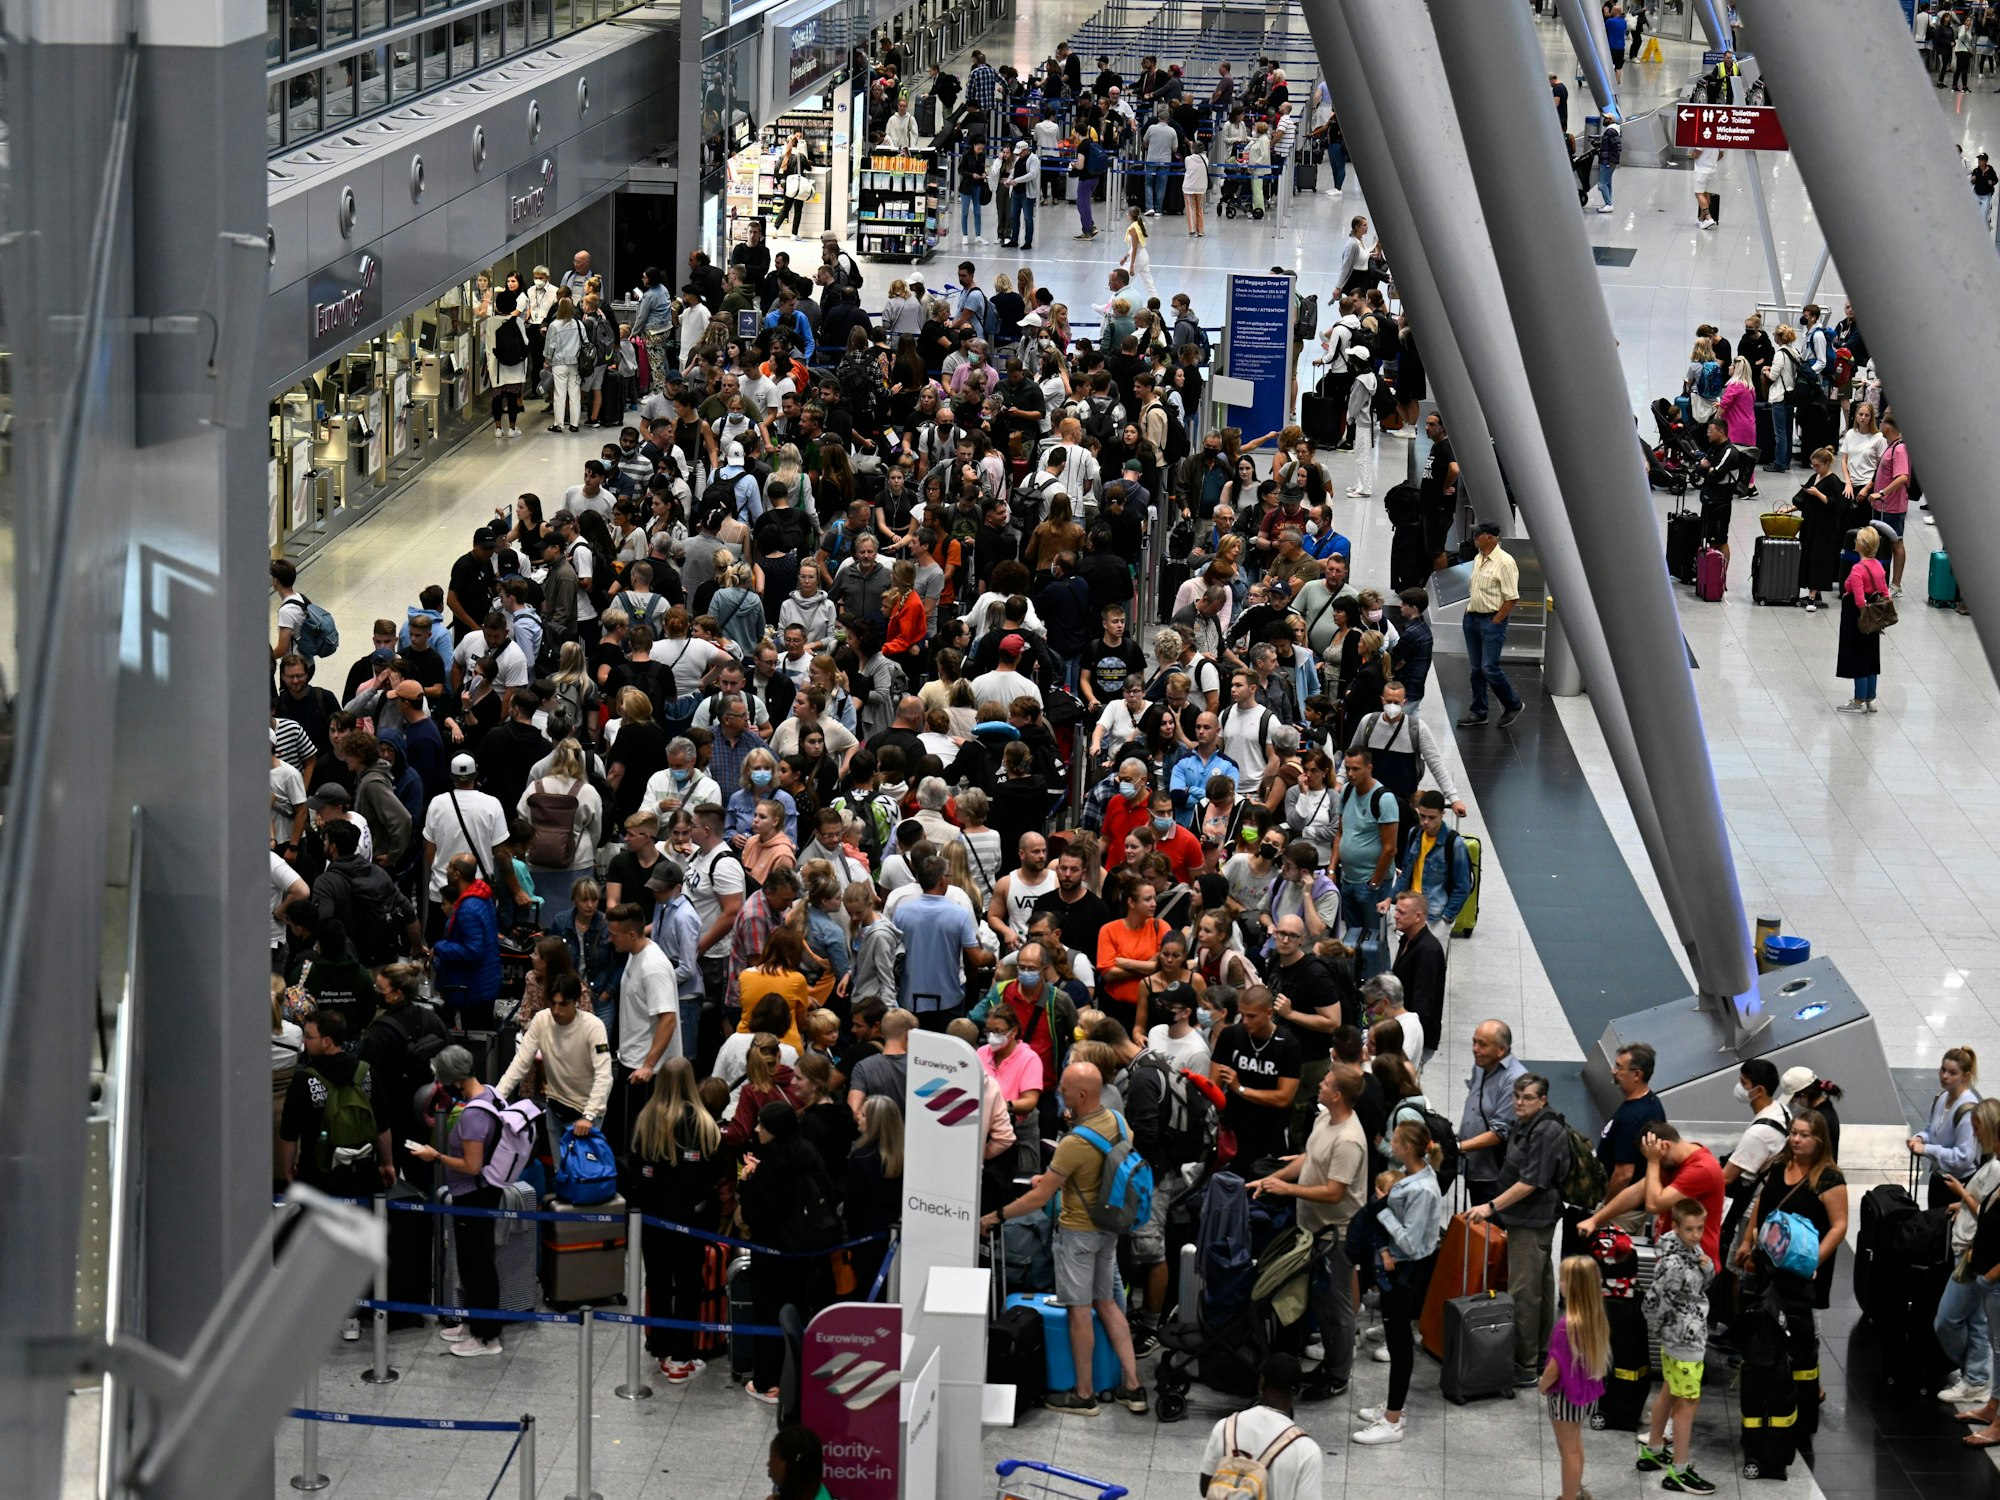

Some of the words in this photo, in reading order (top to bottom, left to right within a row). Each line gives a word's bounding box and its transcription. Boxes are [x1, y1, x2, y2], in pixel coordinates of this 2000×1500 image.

[1731, 109, 1759, 117] Toiletten
[1716, 134, 1732, 142] Baby
[511, 186, 544, 224] Eurowings
[314, 289, 364, 338] Eurowings
[914, 1056, 957, 1073] Eurowings
[1238, 1055, 1278, 1075] BALR.
[410, 1203, 424, 1211] DUS
[908, 1196, 970, 1221] Check-in
[676, 1224, 689, 1233] DUS
[618, 1314, 633, 1322] DUS
[717, 1324, 732, 1332] DUS
[816, 1332, 876, 1346] Eurowings
[334, 1413, 349, 1422] DUS
[440, 1420, 455, 1428] DUS
[822, 1440, 882, 1461] riority-
[822, 1462, 892, 1480] heck-in
